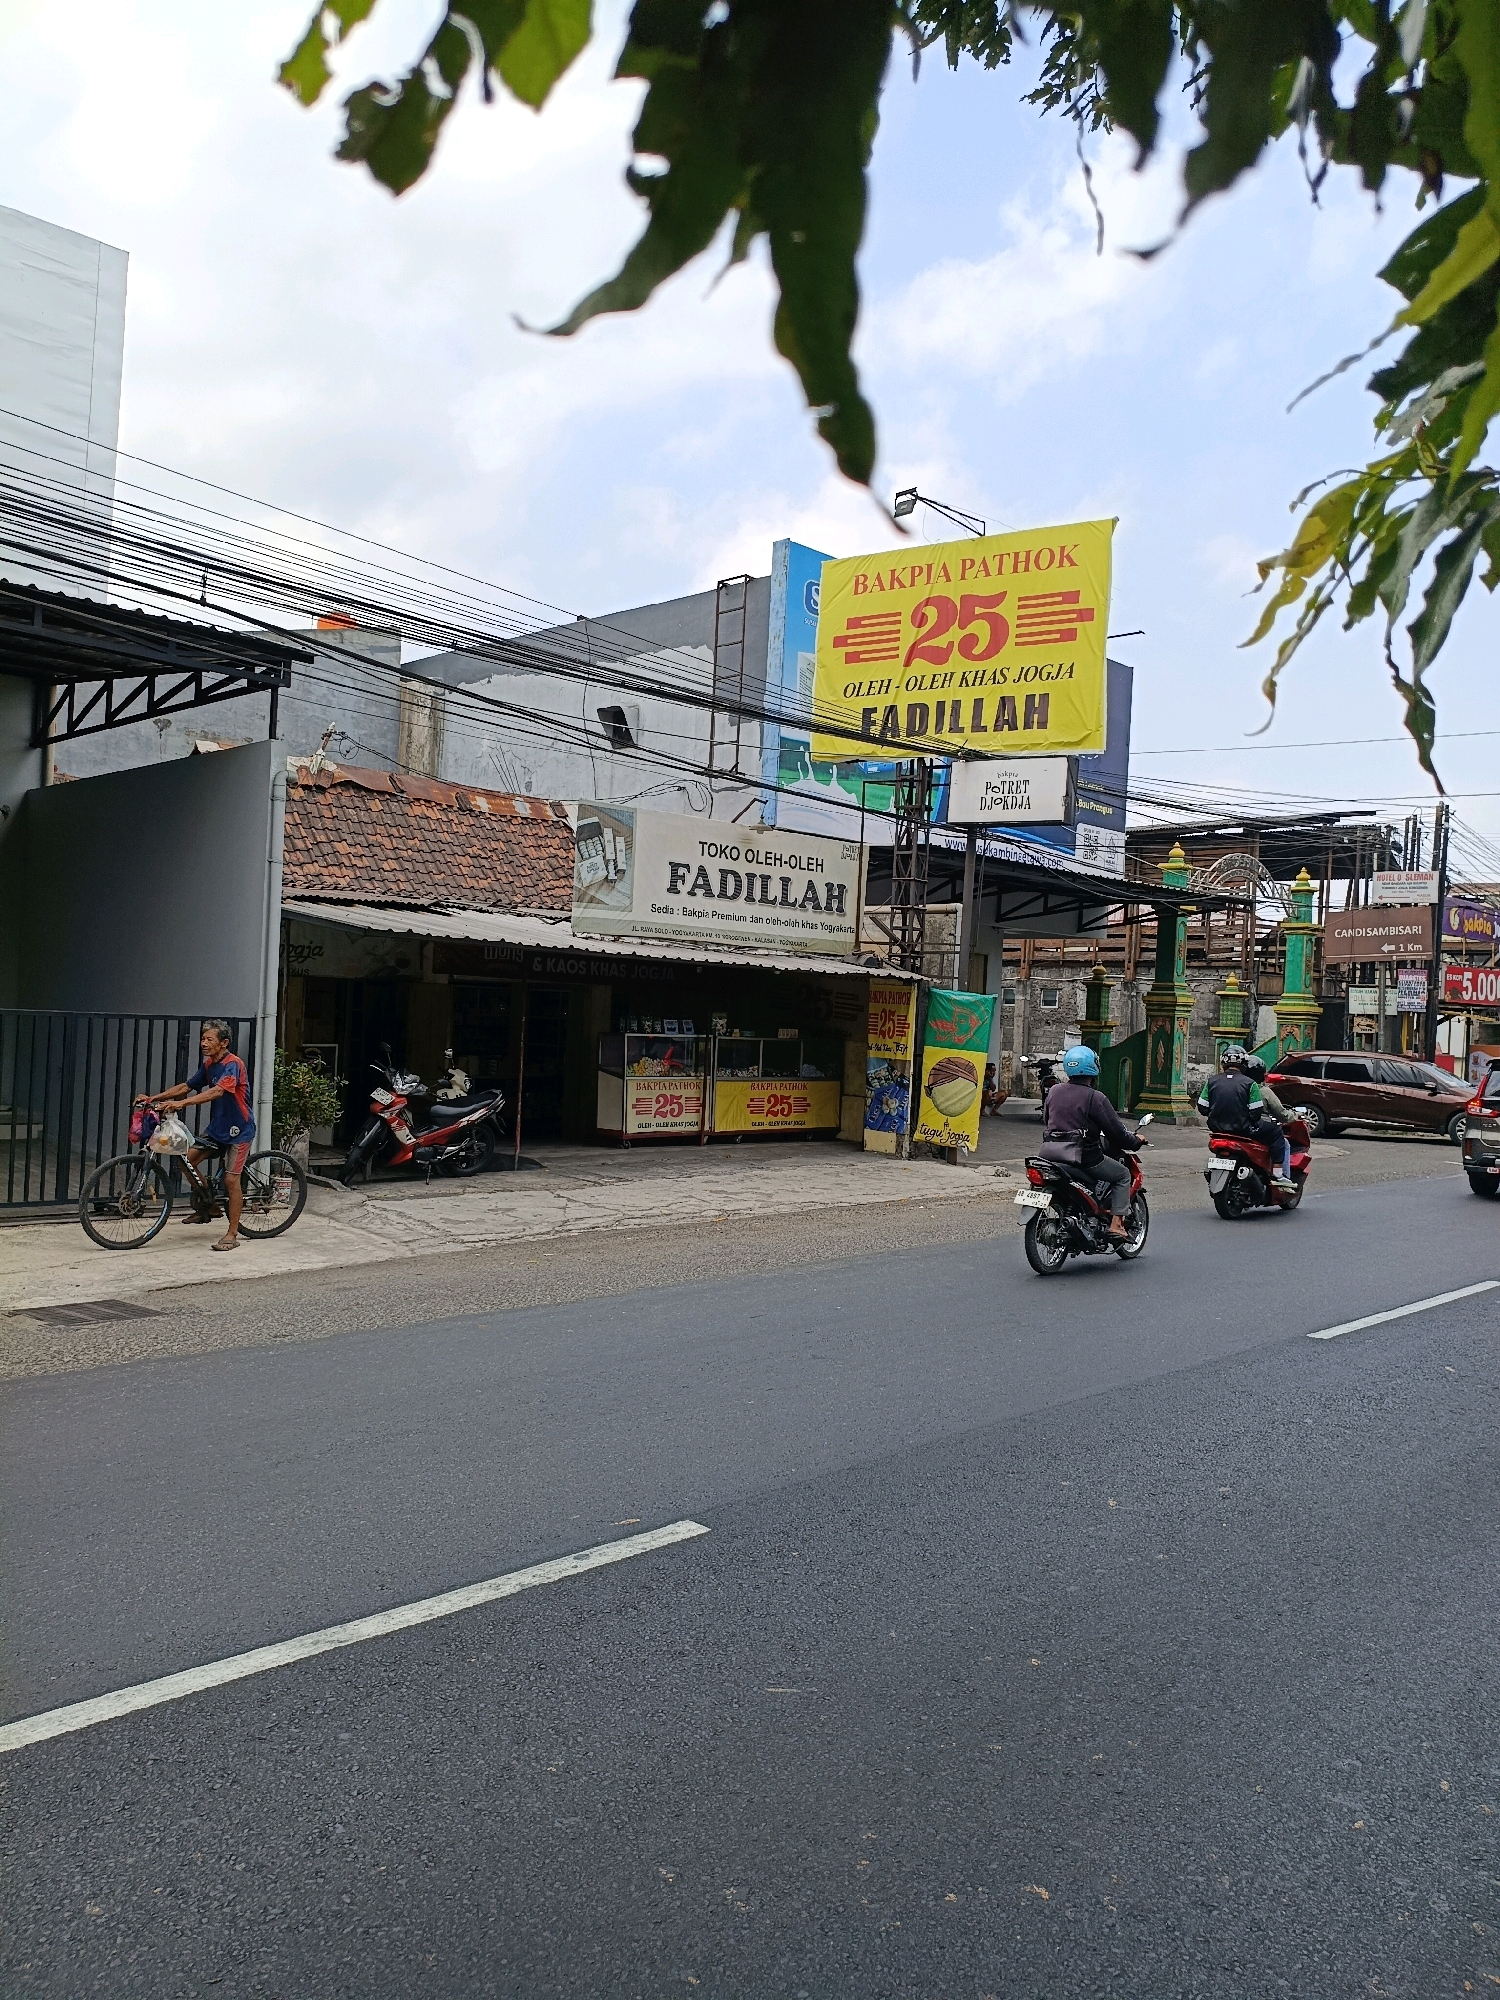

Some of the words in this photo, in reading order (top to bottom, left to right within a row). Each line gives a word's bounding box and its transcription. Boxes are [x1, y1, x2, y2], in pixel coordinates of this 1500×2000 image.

[853, 562, 952, 596] BAKPIA
[960, 544, 1081, 581] PATHOK
[903, 591, 1010, 668] 25
[843, 678, 892, 699] OLEH
[904, 672, 955, 692] OLEH
[958, 667, 1011, 689] KHAS
[1013, 662, 1077, 684] JOGJA
[861, 693, 1050, 740] FADILLAH
[985, 779, 1030, 796] POTRET
[979, 796, 1032, 811] DJOKDJA
[699, 841, 741, 861] TOKO
[745, 849, 824, 873] OLEH-OLEH
[667, 861, 847, 914] FADILLAH
[1377, 873, 1396, 881] HOTEL
[1406, 873, 1434, 881] SLEMAN
[650, 903, 675, 915] Sedia
[682, 908, 709, 920] Bakpia
[711, 910, 747, 923] Premium
[749, 913, 764, 925] dan
[765, 916, 800, 929] oleh-oleh
[801, 919, 818, 930] khas
[819, 921, 856, 934] Yogyakarta
[1463, 910, 1492, 936] bakpia
[1407, 943, 1423, 951] Km
[546, 957, 587, 975] KAOS
[590, 961, 627, 978] KHAS
[630, 964, 675, 981] JOGJA
[879, 1008, 897, 1040] 25
[636, 1082, 669, 1091] BAKPIA
[669, 1081, 701, 1090] PATHOK
[751, 1082, 778, 1091] BAKPIA
[780, 1082, 809, 1091] PATHOK
[653, 1093, 684, 1119] 25
[766, 1093, 793, 1118] 25
[920, 1123, 943, 1142] tugu
[940, 1129, 970, 1146] jogja
